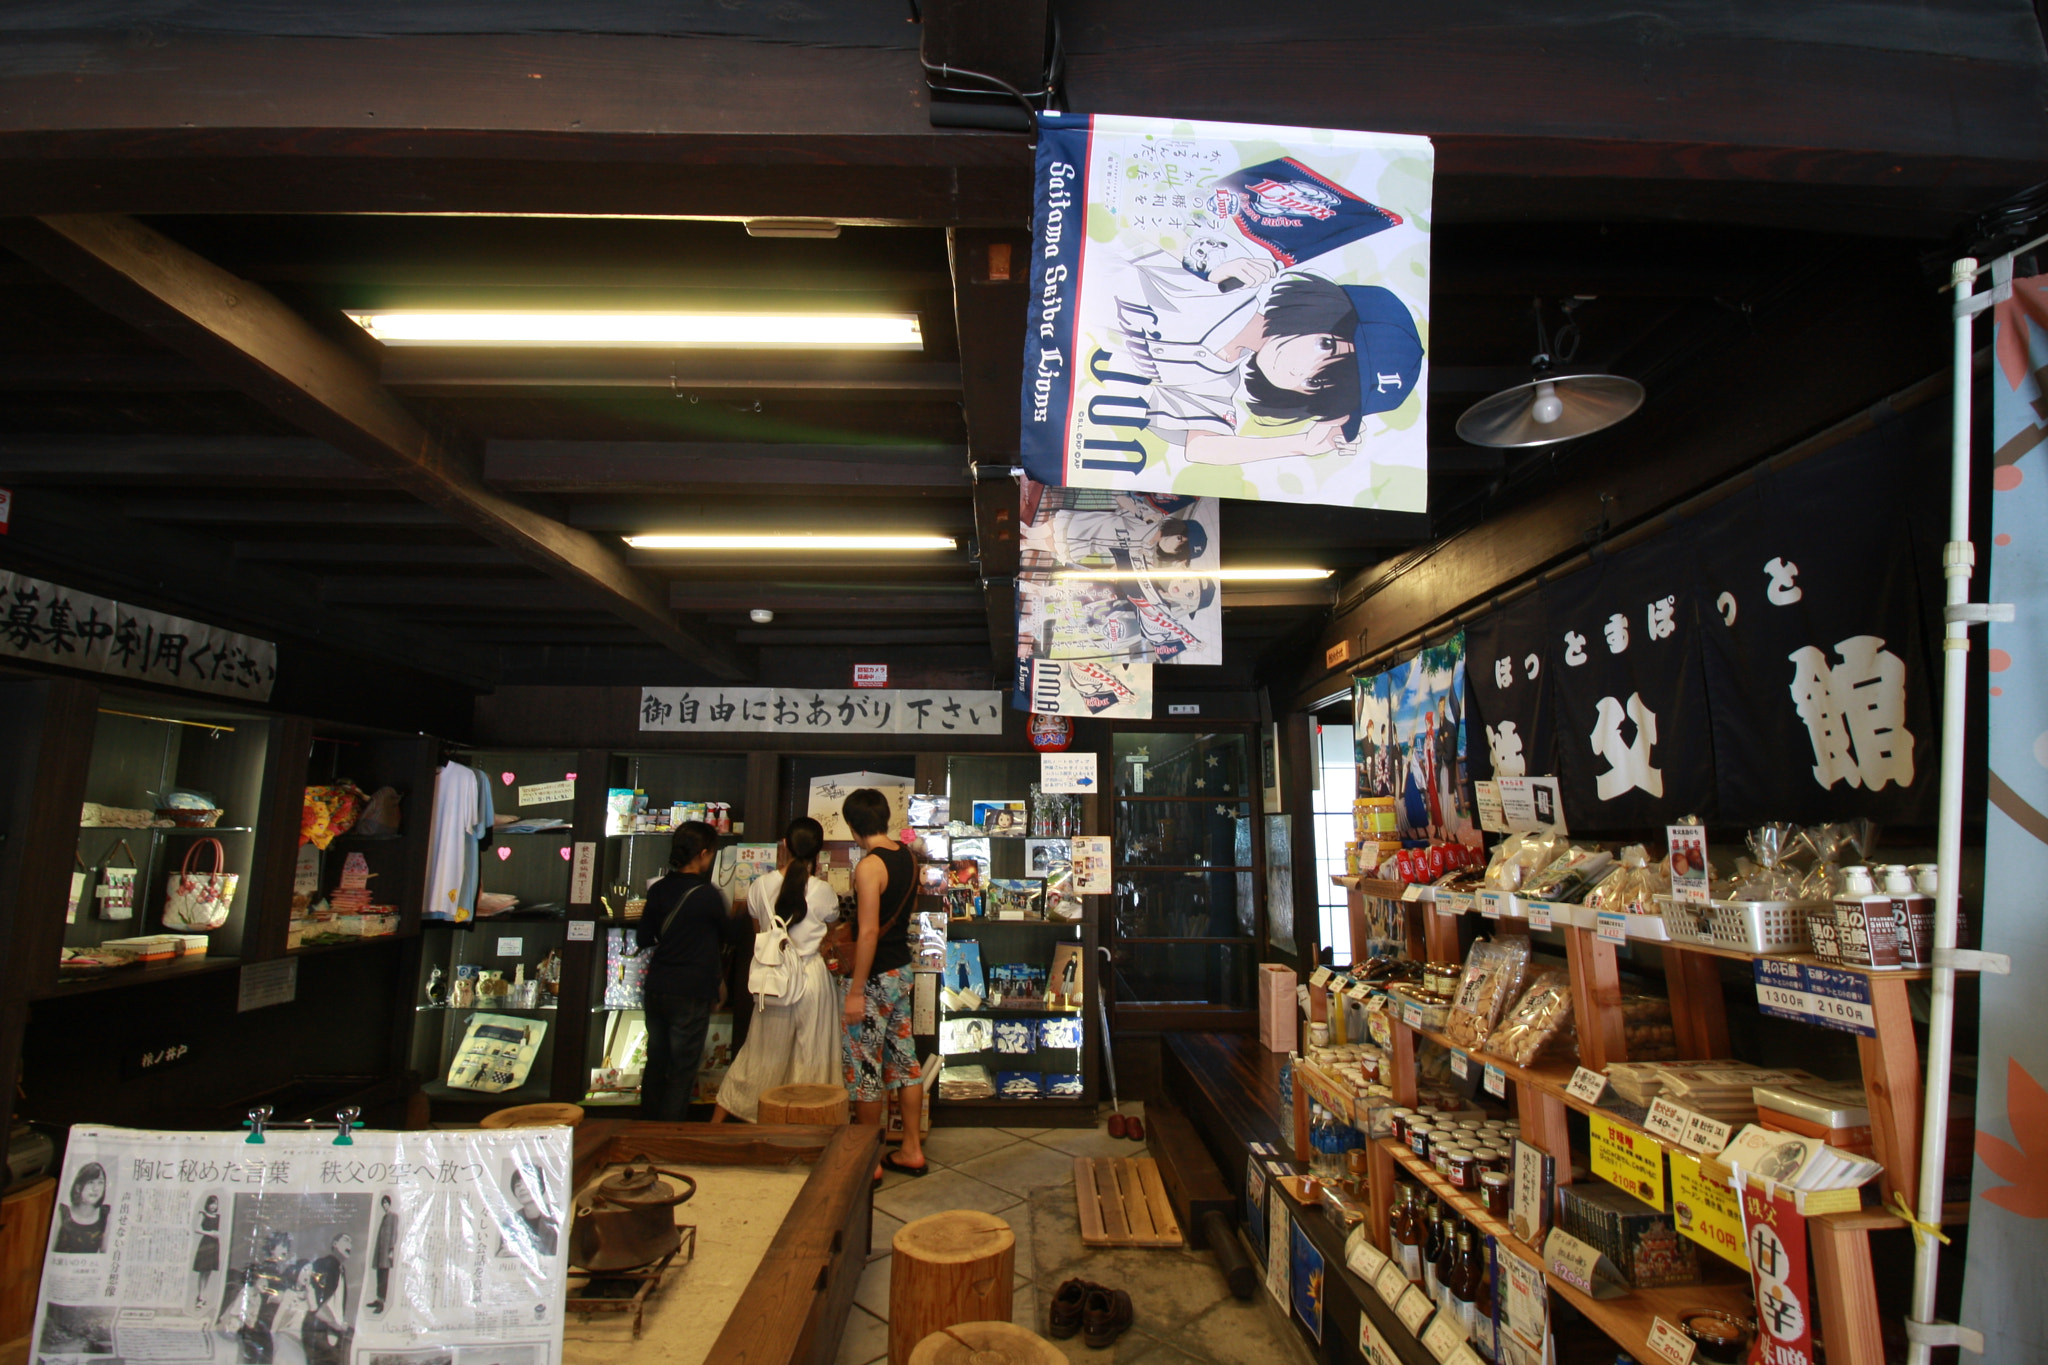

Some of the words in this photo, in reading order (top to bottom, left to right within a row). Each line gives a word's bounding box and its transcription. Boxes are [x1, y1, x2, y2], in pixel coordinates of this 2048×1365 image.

[1044, 160, 1075, 259] Saitama
[1134, 194, 1203, 209] の勝利を
[1216, 189, 1229, 219] Lions
[1244, 178, 1337, 221] Lions
[1133, 214, 1220, 231] ライオンズ
[1039, 264, 1068, 340] Seibu
[1033, 346, 1063, 423] Lions
[1376, 371, 1402, 394] L
[1109, 618, 1120, 642] Lions
[1126, 594, 1197, 644] Lions
[1495, 556, 1801, 689] ほっとすぽっと
[1765, 990, 1804, 1007] 1300円
[1818, 999, 1863, 1020] 2160円
[132, 1158, 291, 1185] 胸に秘めた言葉
[320, 1159, 484, 1186] 秩父の空へ放つ
[1612, 1171, 1637, 1194] 210円
[1746, 1196, 1778, 1227] 秩父
[1700, 1220, 1737, 1252] 410円
